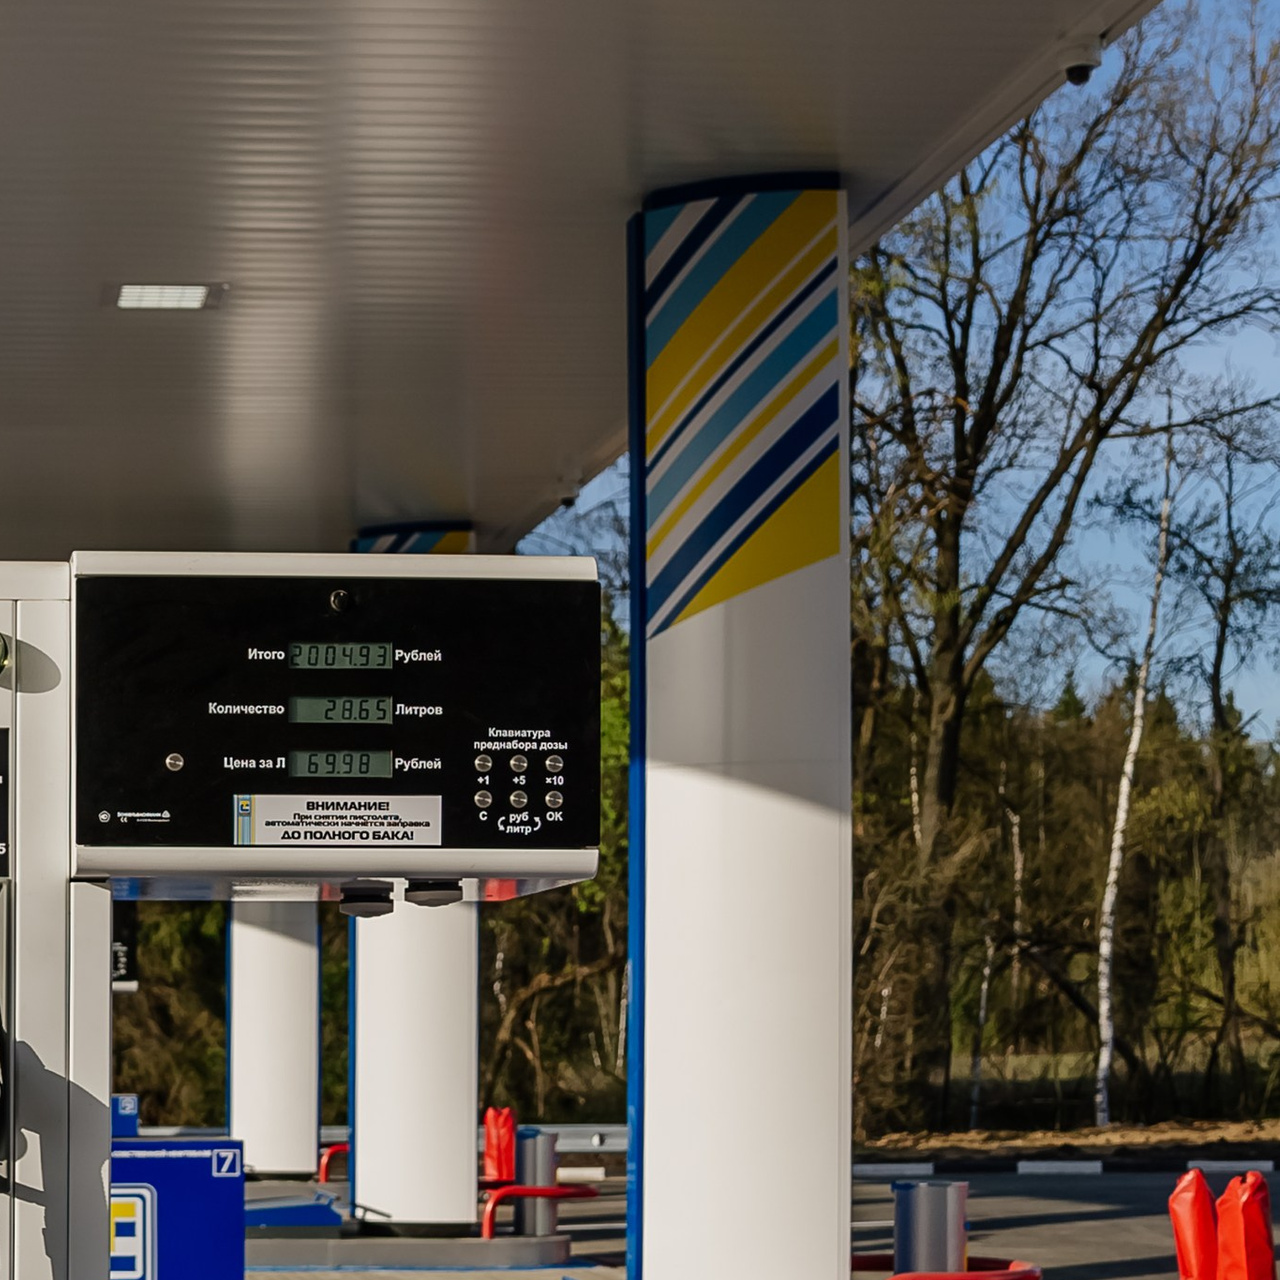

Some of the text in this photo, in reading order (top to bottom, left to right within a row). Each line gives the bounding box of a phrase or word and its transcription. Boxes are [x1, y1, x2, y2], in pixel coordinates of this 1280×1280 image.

[248, 645, 442, 666] Итого 2004.93 Рублей
[208, 699, 443, 720] Количество 28.65 Литров
[488, 728, 551, 739] Клавиатура
[474, 740, 568, 751] преднабора дозы
[223, 753, 442, 774] Цена за Л 69.98 Рублей
[477, 775, 490, 785] +1
[512, 775, 526, 785] +5
[306, 801, 390, 811] ВНИМАНИЕ!
[293, 813, 312, 822] При
[509, 811, 529, 823] руб
[386, 820, 431, 828] заправка
[281, 830, 414, 841] ДО ПОЛНОГО БАКА!
[506, 825, 532, 835] литр
[220, 1151, 235, 1173] 7
